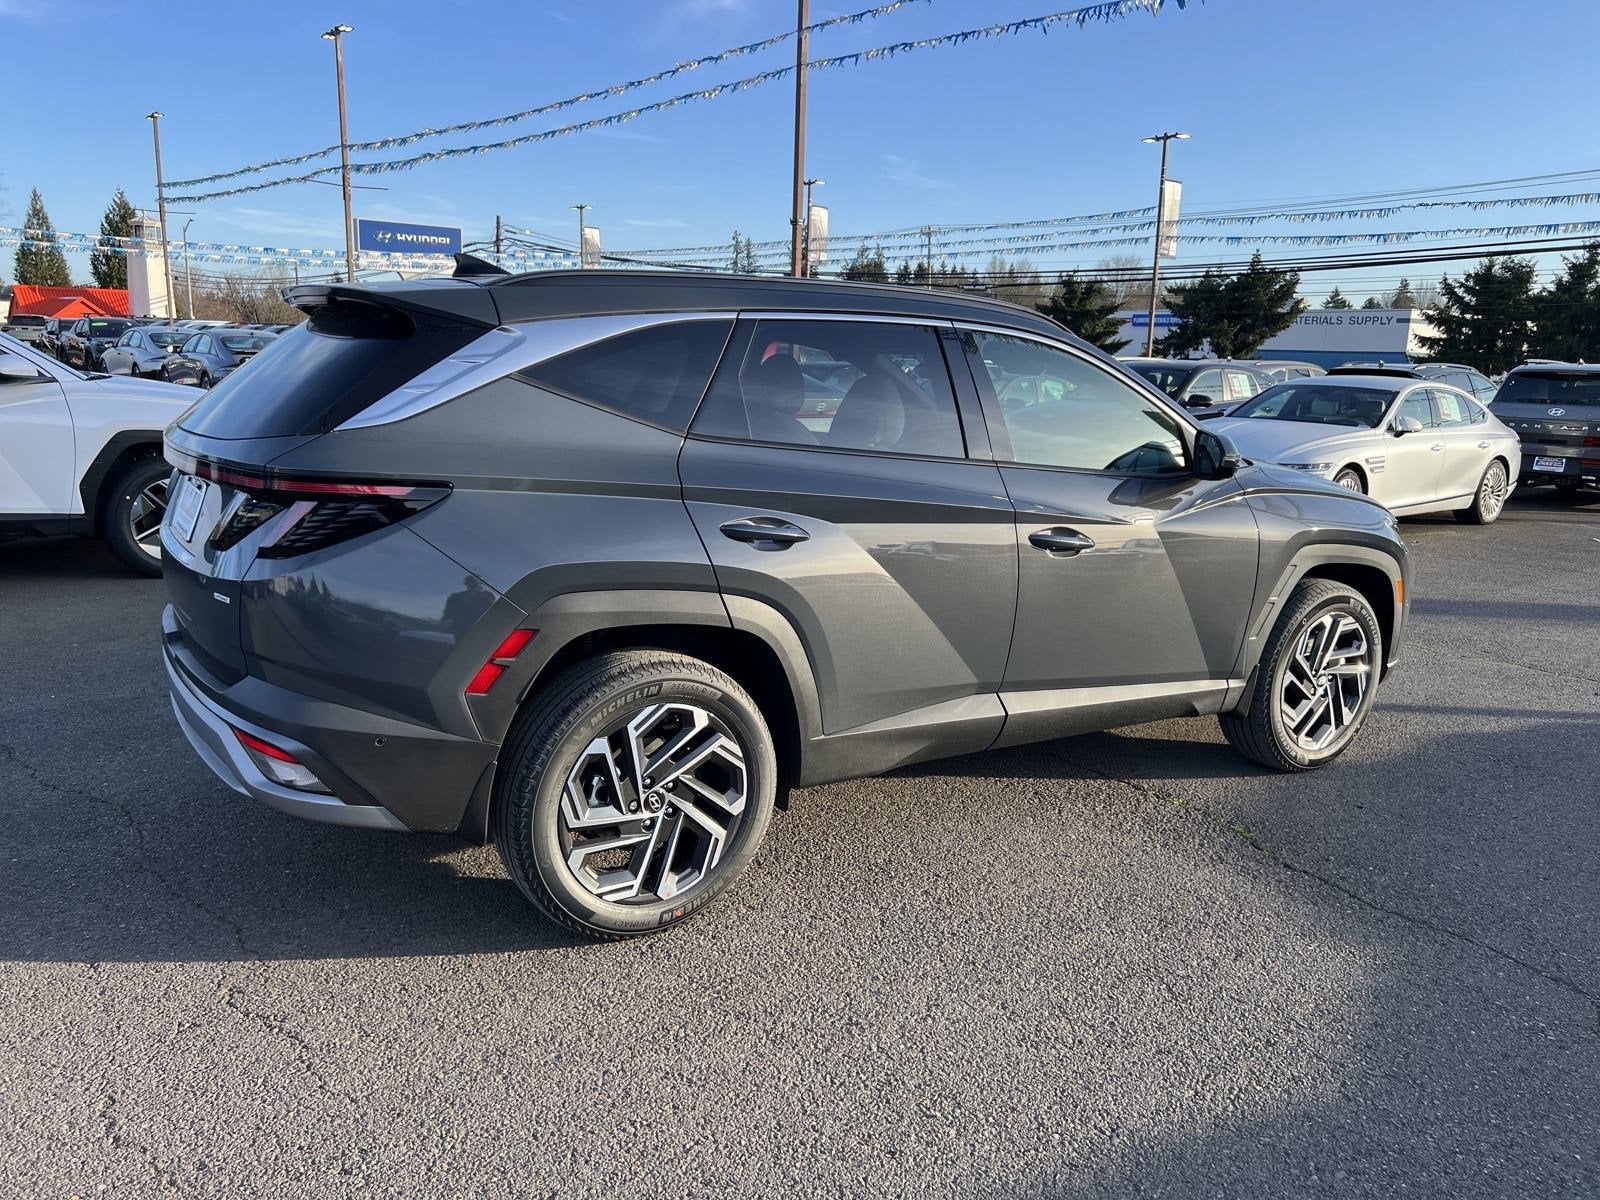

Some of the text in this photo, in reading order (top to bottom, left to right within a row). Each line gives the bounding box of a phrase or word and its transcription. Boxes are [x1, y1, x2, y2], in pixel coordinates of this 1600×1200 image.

[396, 233, 450, 245] HYUNDAI
[1291, 316, 1393, 326] ATERIALS SUPPLY
[1508, 422, 1569, 431] SANTA
[590, 685, 660, 726] MICHELIN
